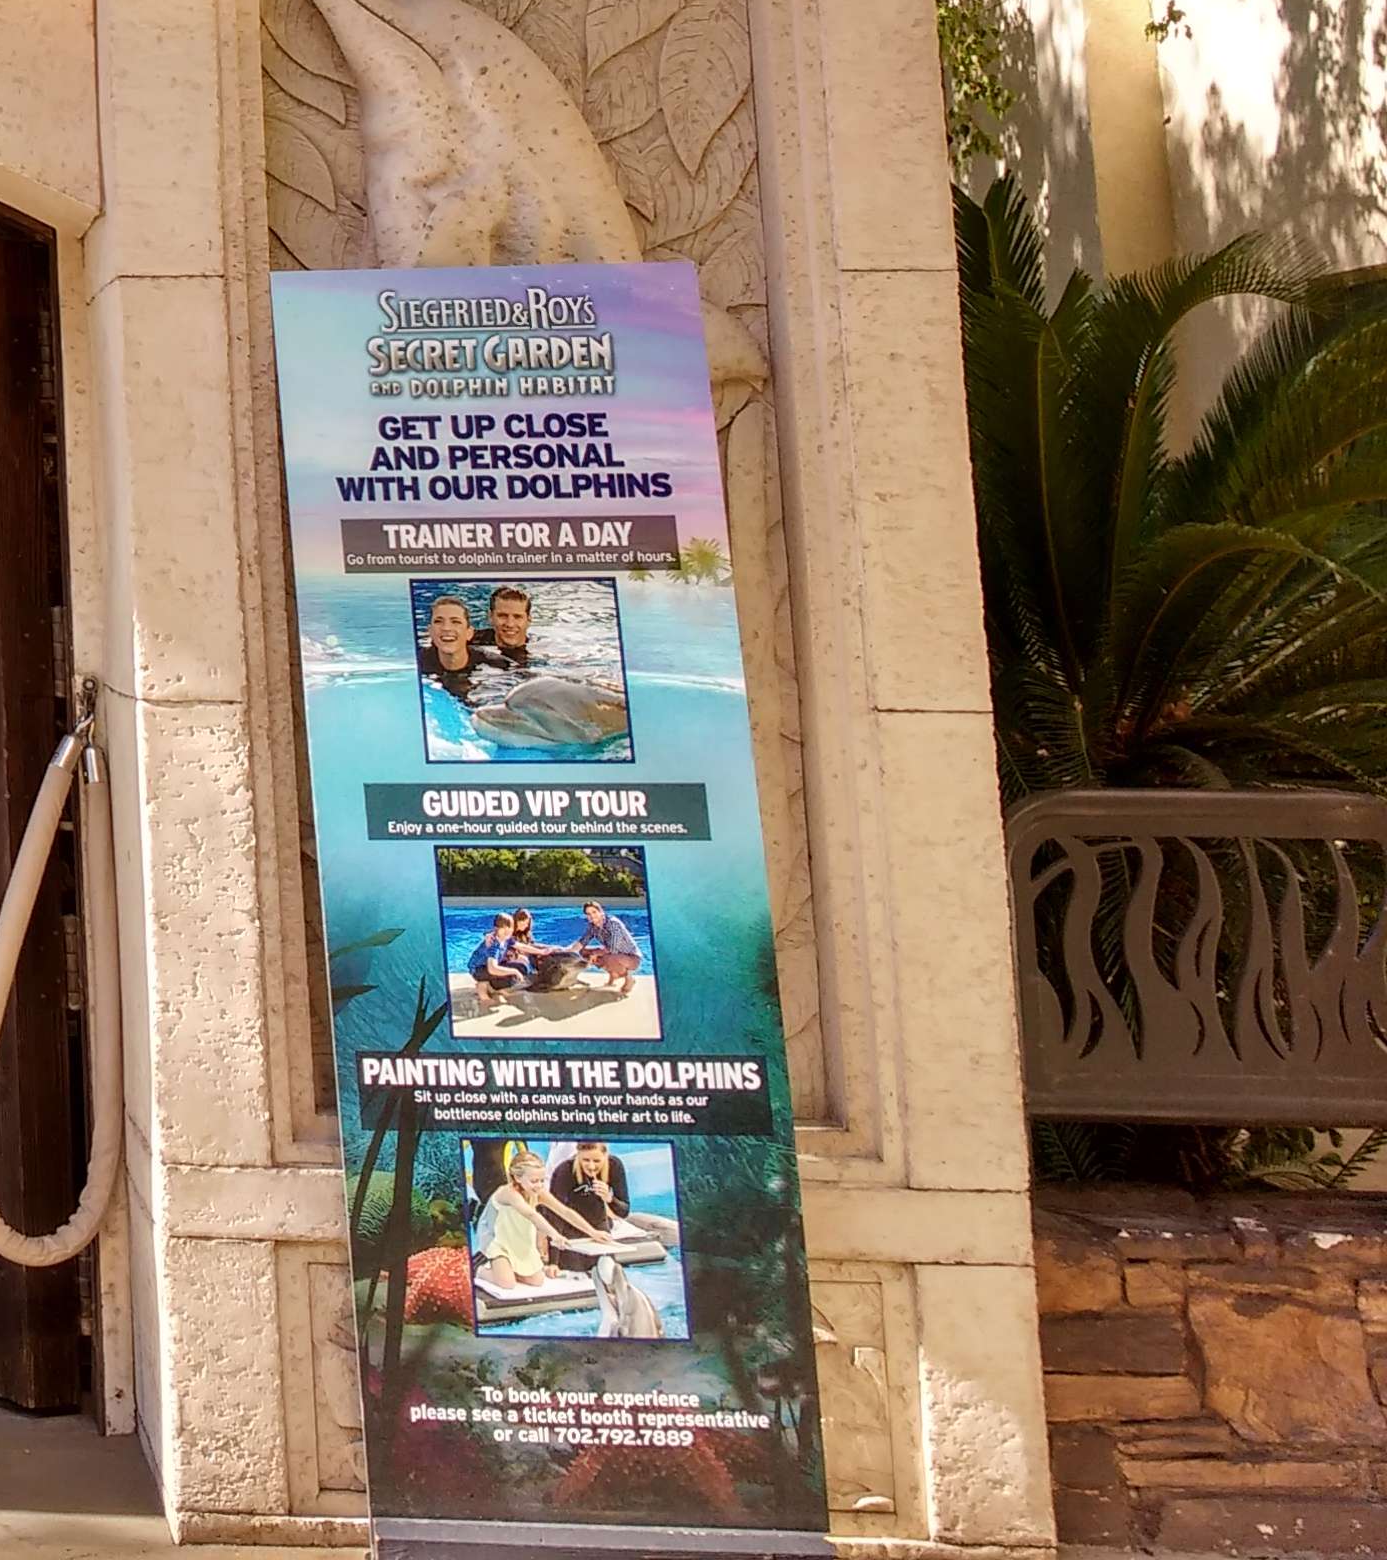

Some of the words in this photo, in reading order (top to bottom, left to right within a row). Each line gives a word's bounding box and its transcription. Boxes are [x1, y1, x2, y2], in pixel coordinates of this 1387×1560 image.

[367, 337, 478, 376] SECRET
[483, 333, 614, 373] GARDEN
[370, 382, 402, 396] AND
[410, 378, 508, 398] DOLPHIN
[519, 376, 615, 395] HABITAT
[379, 415, 441, 440] GET
[451, 415, 495, 439] UP
[504, 412, 608, 438] CLOSE
[369, 446, 439, 470] AND
[448, 443, 625, 470] PERSONAL
[337, 476, 420, 501] WITH
[428, 475, 499, 500] OUR
[507, 473, 672, 499] DOLPHINS
[383, 524, 494, 549] TRAINER
[500, 522, 551, 548] FOR
[558, 522, 577, 547] A
[582, 522, 632, 547] DAY
[347, 554, 363, 565] Go
[367, 554, 395, 565] from
[399, 553, 439, 565] tourist
[443, 555, 455, 564] to
[459, 553, 502, 566] dolphin
[507, 553, 548, 564] trainer
[551, 552, 562, 563] in
[566, 554, 573, 563] a
[577, 553, 617, 563] matter
[622, 551, 634, 562] of
[638, 552, 676, 562] hours.
[422, 790, 520, 817] GUIDED
[525, 791, 570, 817] VIP
[576, 791, 647, 817] TOUR
[388, 822, 422, 835] Enjoy
[426, 824, 433, 833] a
[437, 822, 491, 833] one-hour
[496, 822, 538, 835] guided
[541, 822, 566, 833] tour
[571, 822, 612, 833] behind
[616, 822, 637, 833] the
[640, 823, 687, 834] scenes.
[362, 1058, 486, 1087] PAINTING
[491, 1060, 561, 1087] WITH
[565, 1061, 621, 1089] THE
[625, 1061, 761, 1090] DOLPHINS
[414, 1091, 432, 1103] Sit
[435, 1092, 451, 1106] up
[455, 1091, 487, 1103] close
[490, 1091, 518, 1103] with
[521, 1094, 529, 1103] a
[532, 1093, 576, 1104] canvas
[579, 1093, 591, 1105] in
[594, 1095, 623, 1108] your
[626, 1093, 665, 1106] hands
[668, 1096, 684, 1106] as
[686, 1096, 709, 1107] our
[435, 1108, 501, 1121] bottlenose
[505, 1109, 558, 1123] dolphins
[562, 1110, 595, 1125] bring
[599, 1110, 628, 1122] their
[632, 1111, 652, 1123] art
[654, 1111, 669, 1123] to
[671, 1111, 696, 1124] life.
[481, 1386, 503, 1402] To
[509, 1388, 552, 1404] book
[556, 1392, 598, 1407] your
[603, 1390, 700, 1408] experience
[410, 1403, 466, 1422] please
[472, 1409, 502, 1422] see
[507, 1410, 519, 1422] a
[523, 1407, 575, 1424] ticket
[581, 1409, 633, 1426] booth
[638, 1411, 770, 1429] representative
[493, 1429, 513, 1441] or
[518, 1427, 549, 1443] call
[553, 1427, 694, 1447] 702.792.7889
